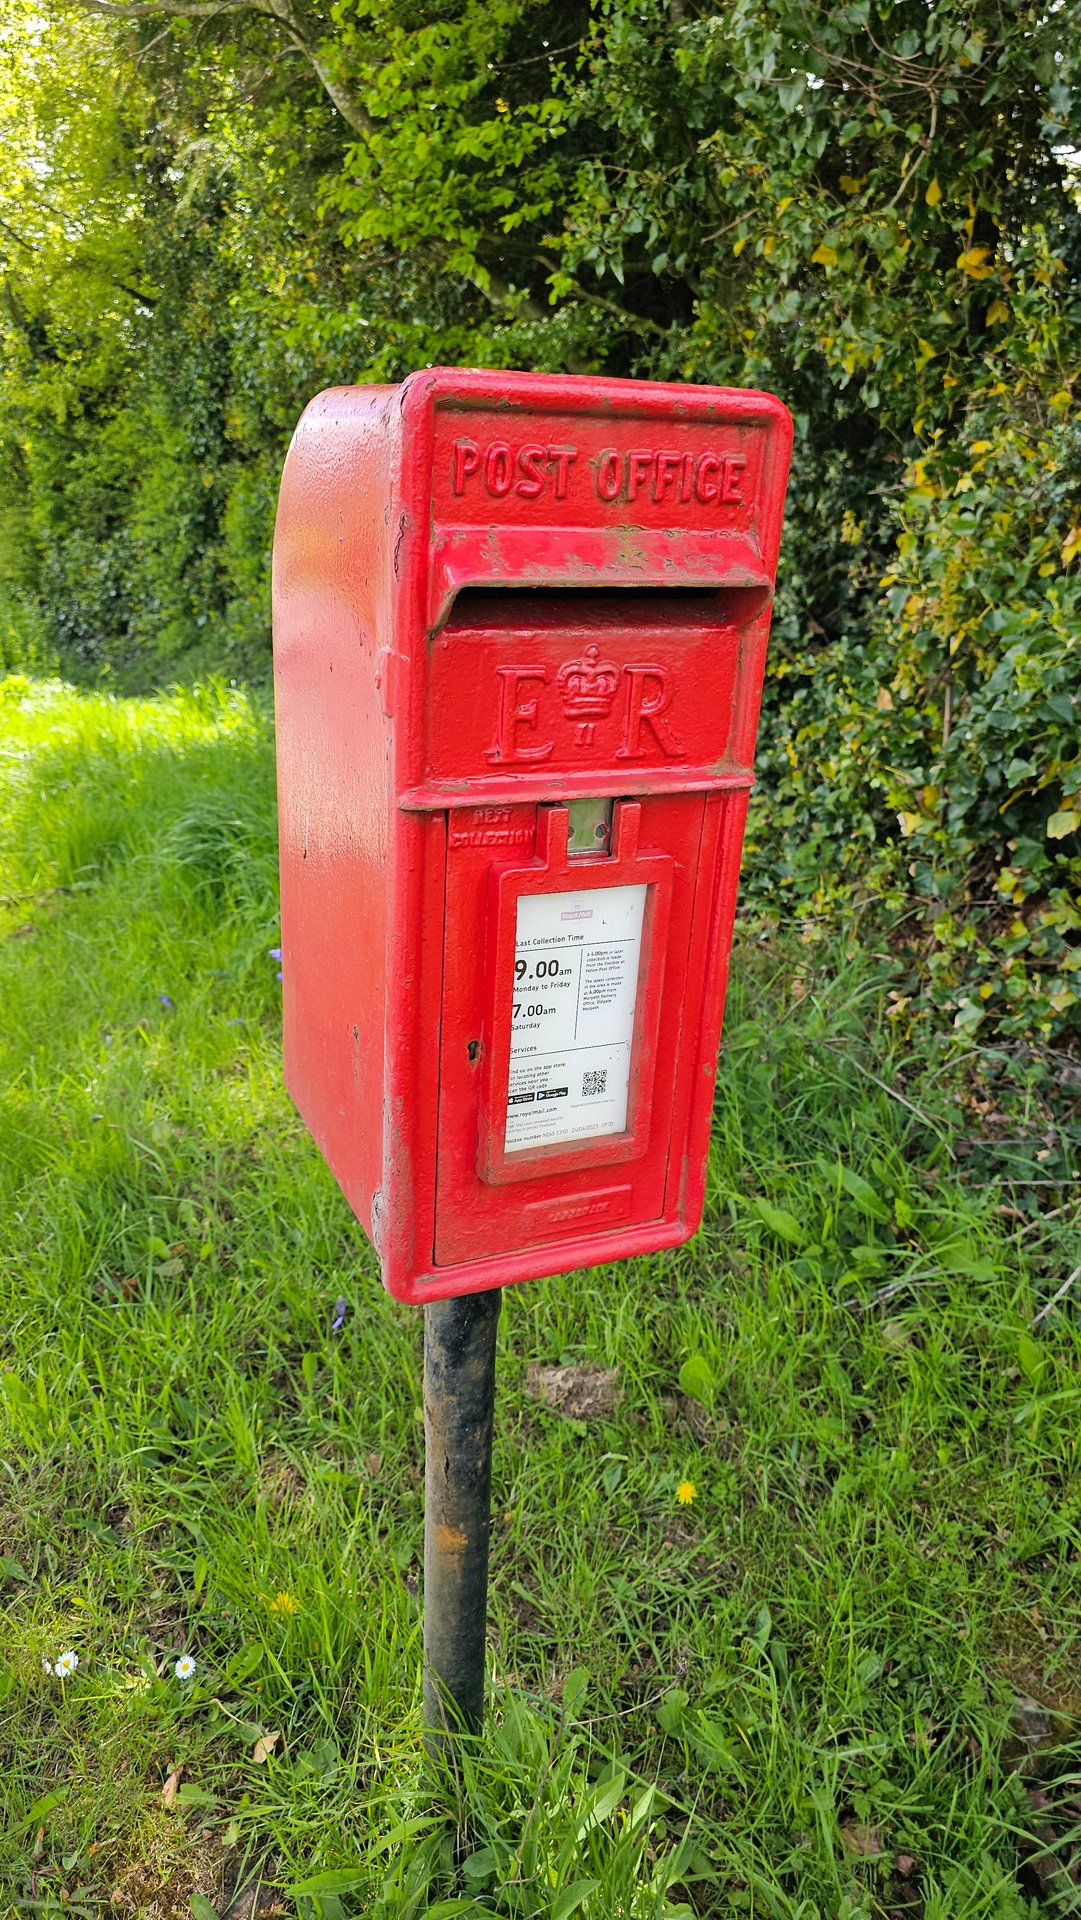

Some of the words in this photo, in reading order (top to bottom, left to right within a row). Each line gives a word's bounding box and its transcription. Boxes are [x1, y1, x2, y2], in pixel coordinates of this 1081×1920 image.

[452, 438, 577, 498] POST
[594, 448, 748, 503] OFFICE
[484, 664, 552, 764] E
[616, 663, 687, 760] R
[533, 936, 566, 946] Collection
[513, 985, 539, 993] Monday
[550, 981, 571, 989] Friday
[511, 1022, 541, 1031] Saturday
